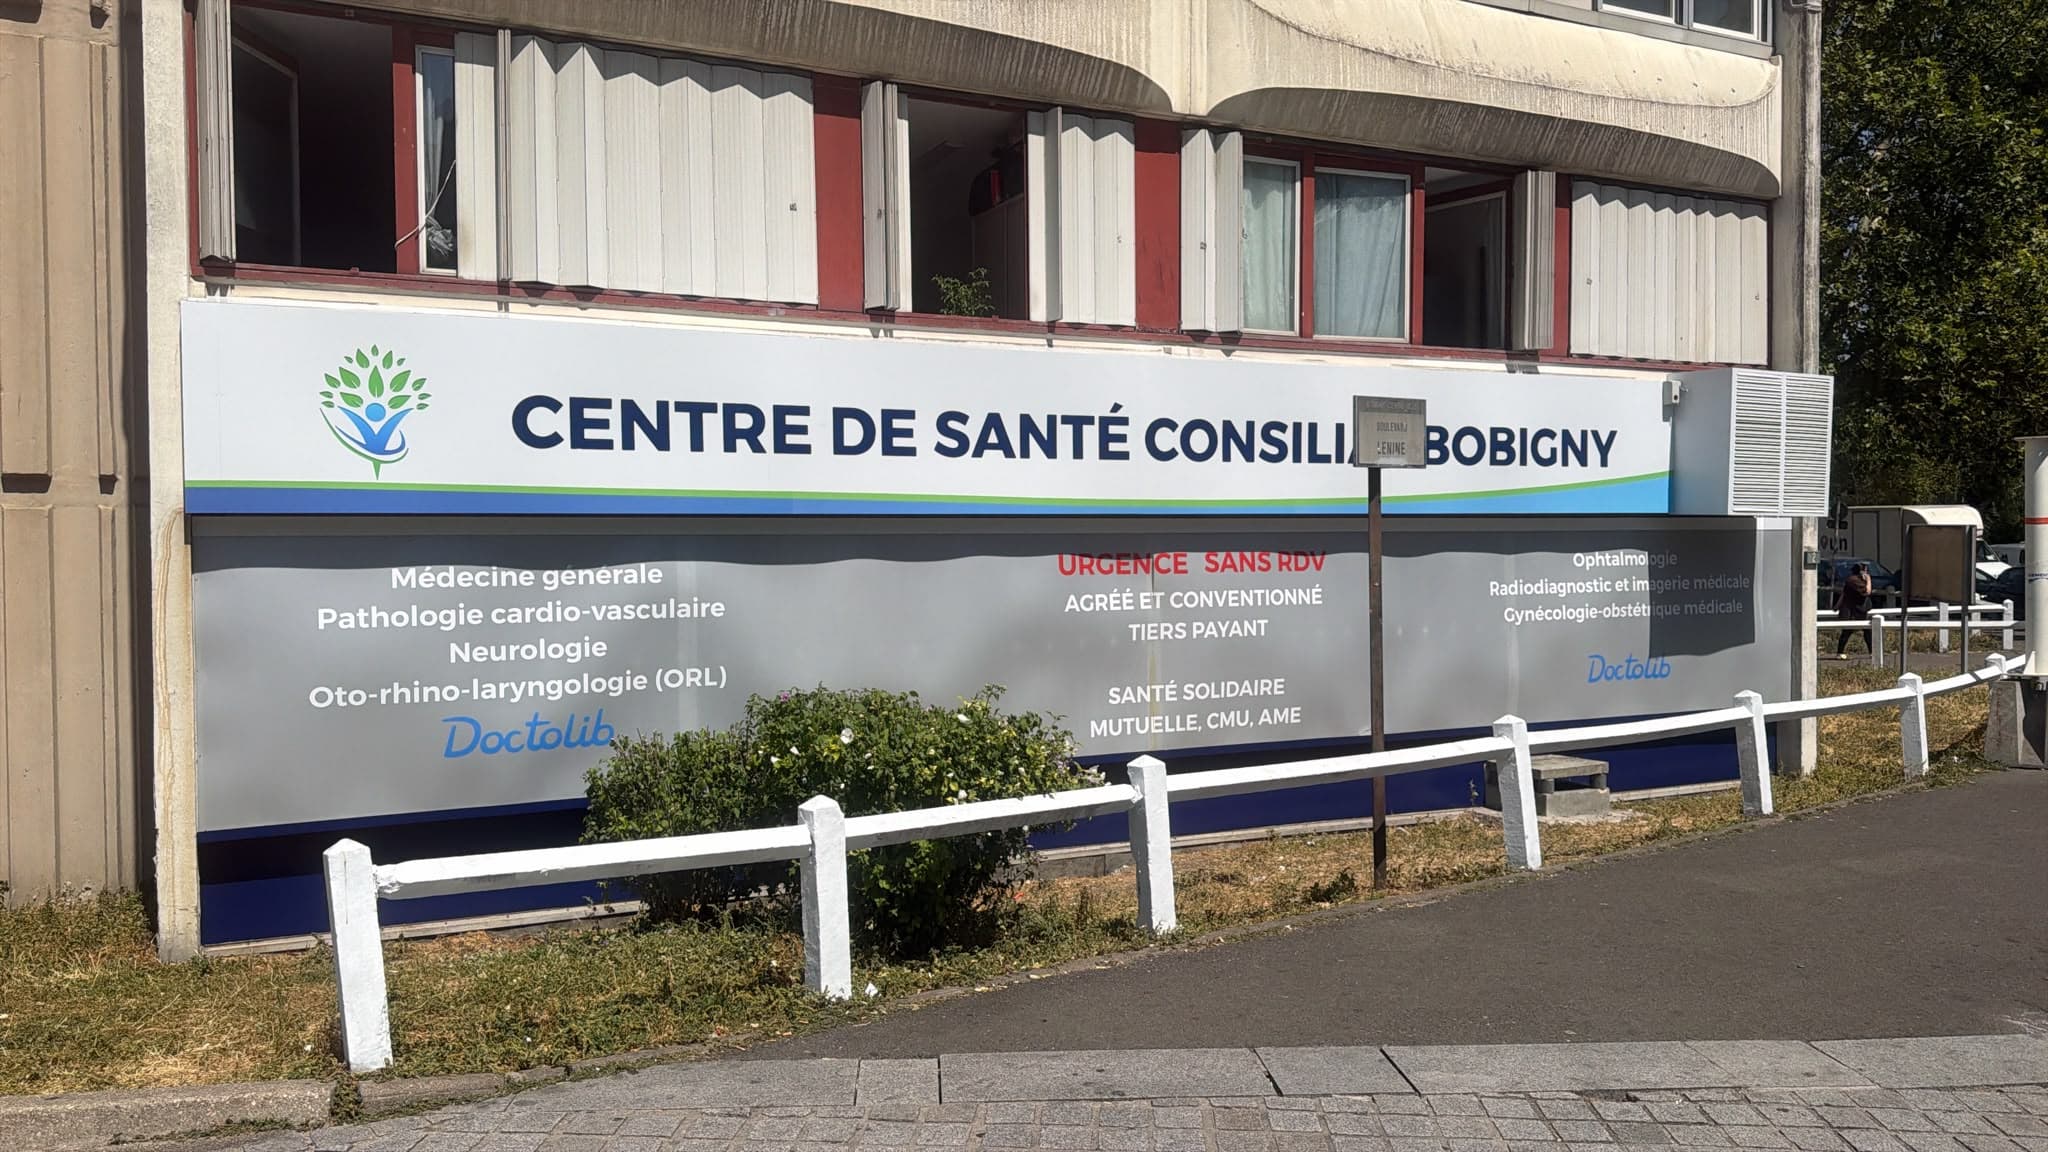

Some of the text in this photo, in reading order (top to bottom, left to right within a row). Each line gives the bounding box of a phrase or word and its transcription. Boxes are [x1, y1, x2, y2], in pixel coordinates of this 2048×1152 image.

[511, 394, 1618, 467] CENTRE DE SANTÉ CONSILI BOBIGNY
[1377, 441, 1406, 455] LENINE
[1057, 551, 1326, 576] URGENCE SANS RDV
[1572, 551, 1678, 571] Ophtalmologie
[391, 563, 663, 591] Médecine générale
[1489, 574, 1750, 597] Radiodiagnostic et imagerie médicale
[1064, 584, 1323, 613] AGRÉÉ ET CONVENTIONNÉ
[1503, 598, 1744, 626] Gynécologie-obstétrique médicale
[317, 597, 726, 631] Pathologie cardio-vasculaire
[1128, 619, 1268, 641] TIERS PAYANT
[449, 636, 608, 663] Neurologie
[1587, 653, 1672, 684] Doctolib
[309, 666, 727, 708] Oto-rhino-laryngologie (ORL)
[1108, 678, 1285, 705] SANTÉ SOLIDAIRE
[441, 708, 615, 759] Doctolib
[1090, 707, 1301, 738] MUTUELLE, CMU, AME
